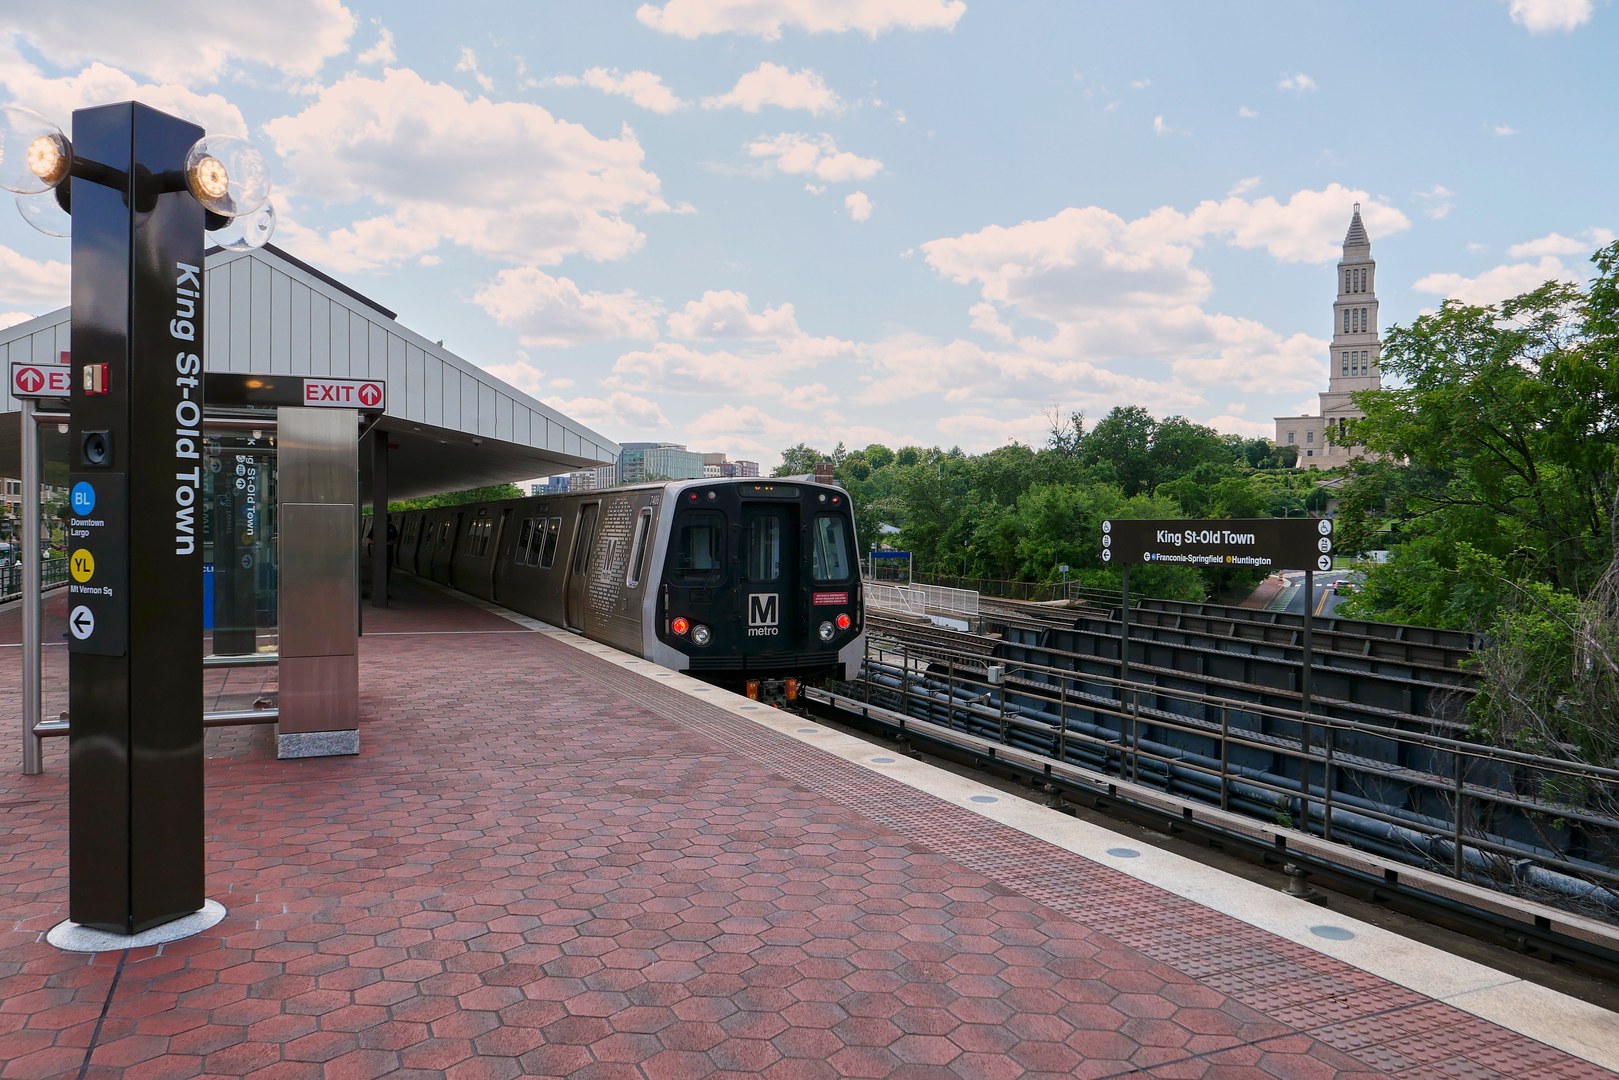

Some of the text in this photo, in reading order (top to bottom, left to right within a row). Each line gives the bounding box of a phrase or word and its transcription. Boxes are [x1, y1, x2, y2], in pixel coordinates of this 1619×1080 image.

[306, 384, 354, 402] EXIT
[170, 262, 200, 555] King St-Old Town
[247, 468, 255, 504] St-Old
[75, 492, 90, 505] BL
[70, 518, 104, 527] Downtown
[247, 506, 255, 535] Town
[70, 528, 90, 538] Largo
[1157, 530, 1255, 546] King St-Old Town
[74, 558, 91, 572] YL
[1156, 553, 1223, 564] Franconia-Springfield
[1231, 555, 1271, 566] Huntington
[70, 585, 113, 597] Mt Vernon Sq
[750, 595, 777, 624] M
[748, 626, 779, 637] metro
